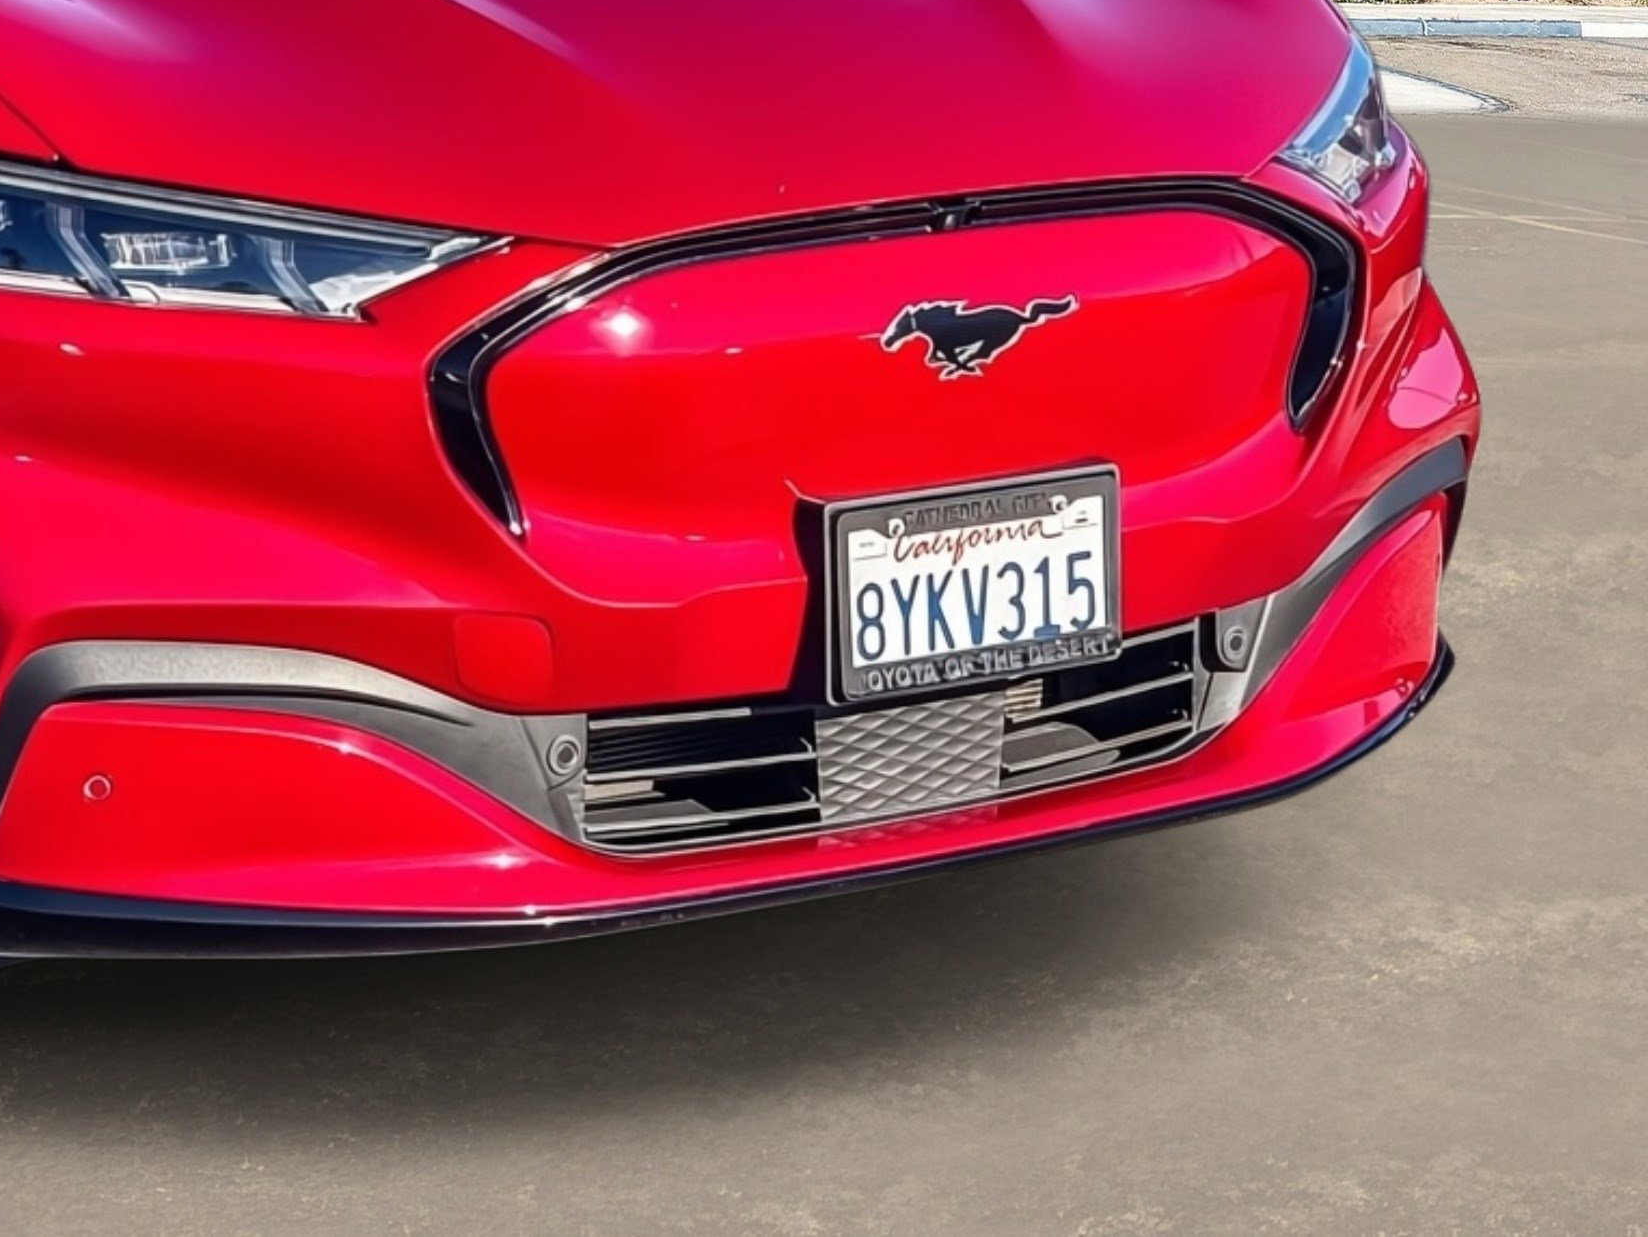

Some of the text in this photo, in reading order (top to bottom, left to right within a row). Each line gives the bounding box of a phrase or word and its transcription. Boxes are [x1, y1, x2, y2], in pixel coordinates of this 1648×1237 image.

[892, 516, 1063, 564] California
[856, 550, 1097, 661] 8YKV315
[1028, 634, 1113, 666] DESERT
